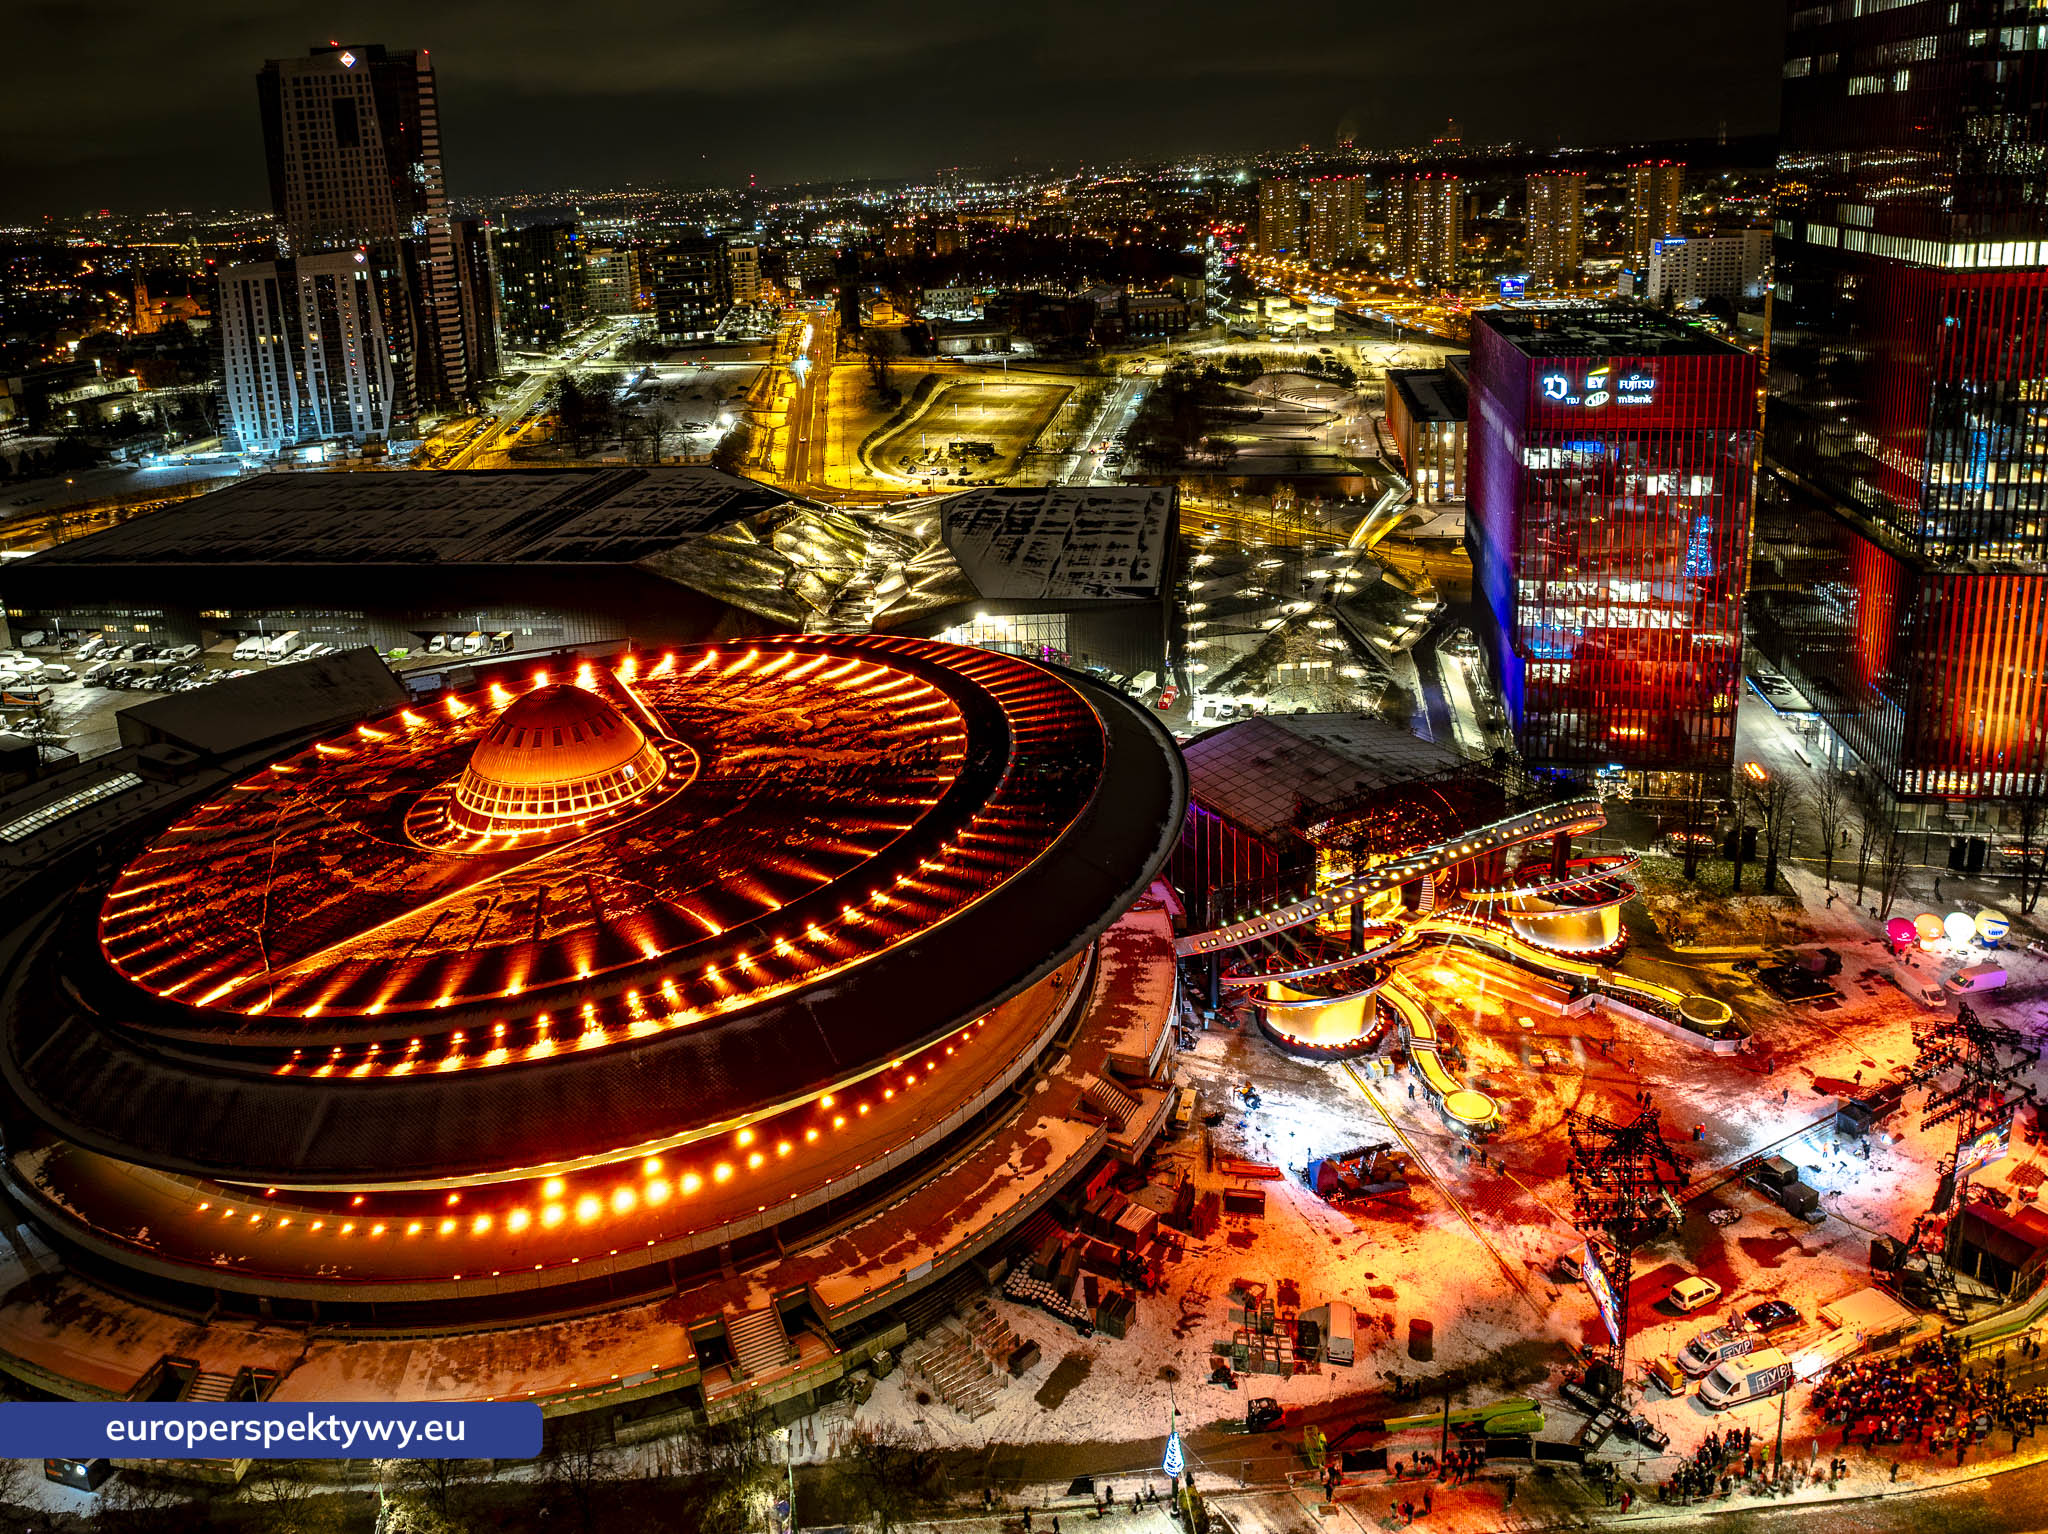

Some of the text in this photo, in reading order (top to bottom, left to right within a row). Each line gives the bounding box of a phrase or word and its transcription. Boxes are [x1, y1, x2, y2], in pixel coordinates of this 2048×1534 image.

[1587, 376, 1605, 389] EY
[1565, 396, 1580, 405] TDJ
[1617, 394, 1653, 404] mBank
[1725, 1339, 1751, 1358] TVP
[1757, 1365, 1789, 1388] TVP
